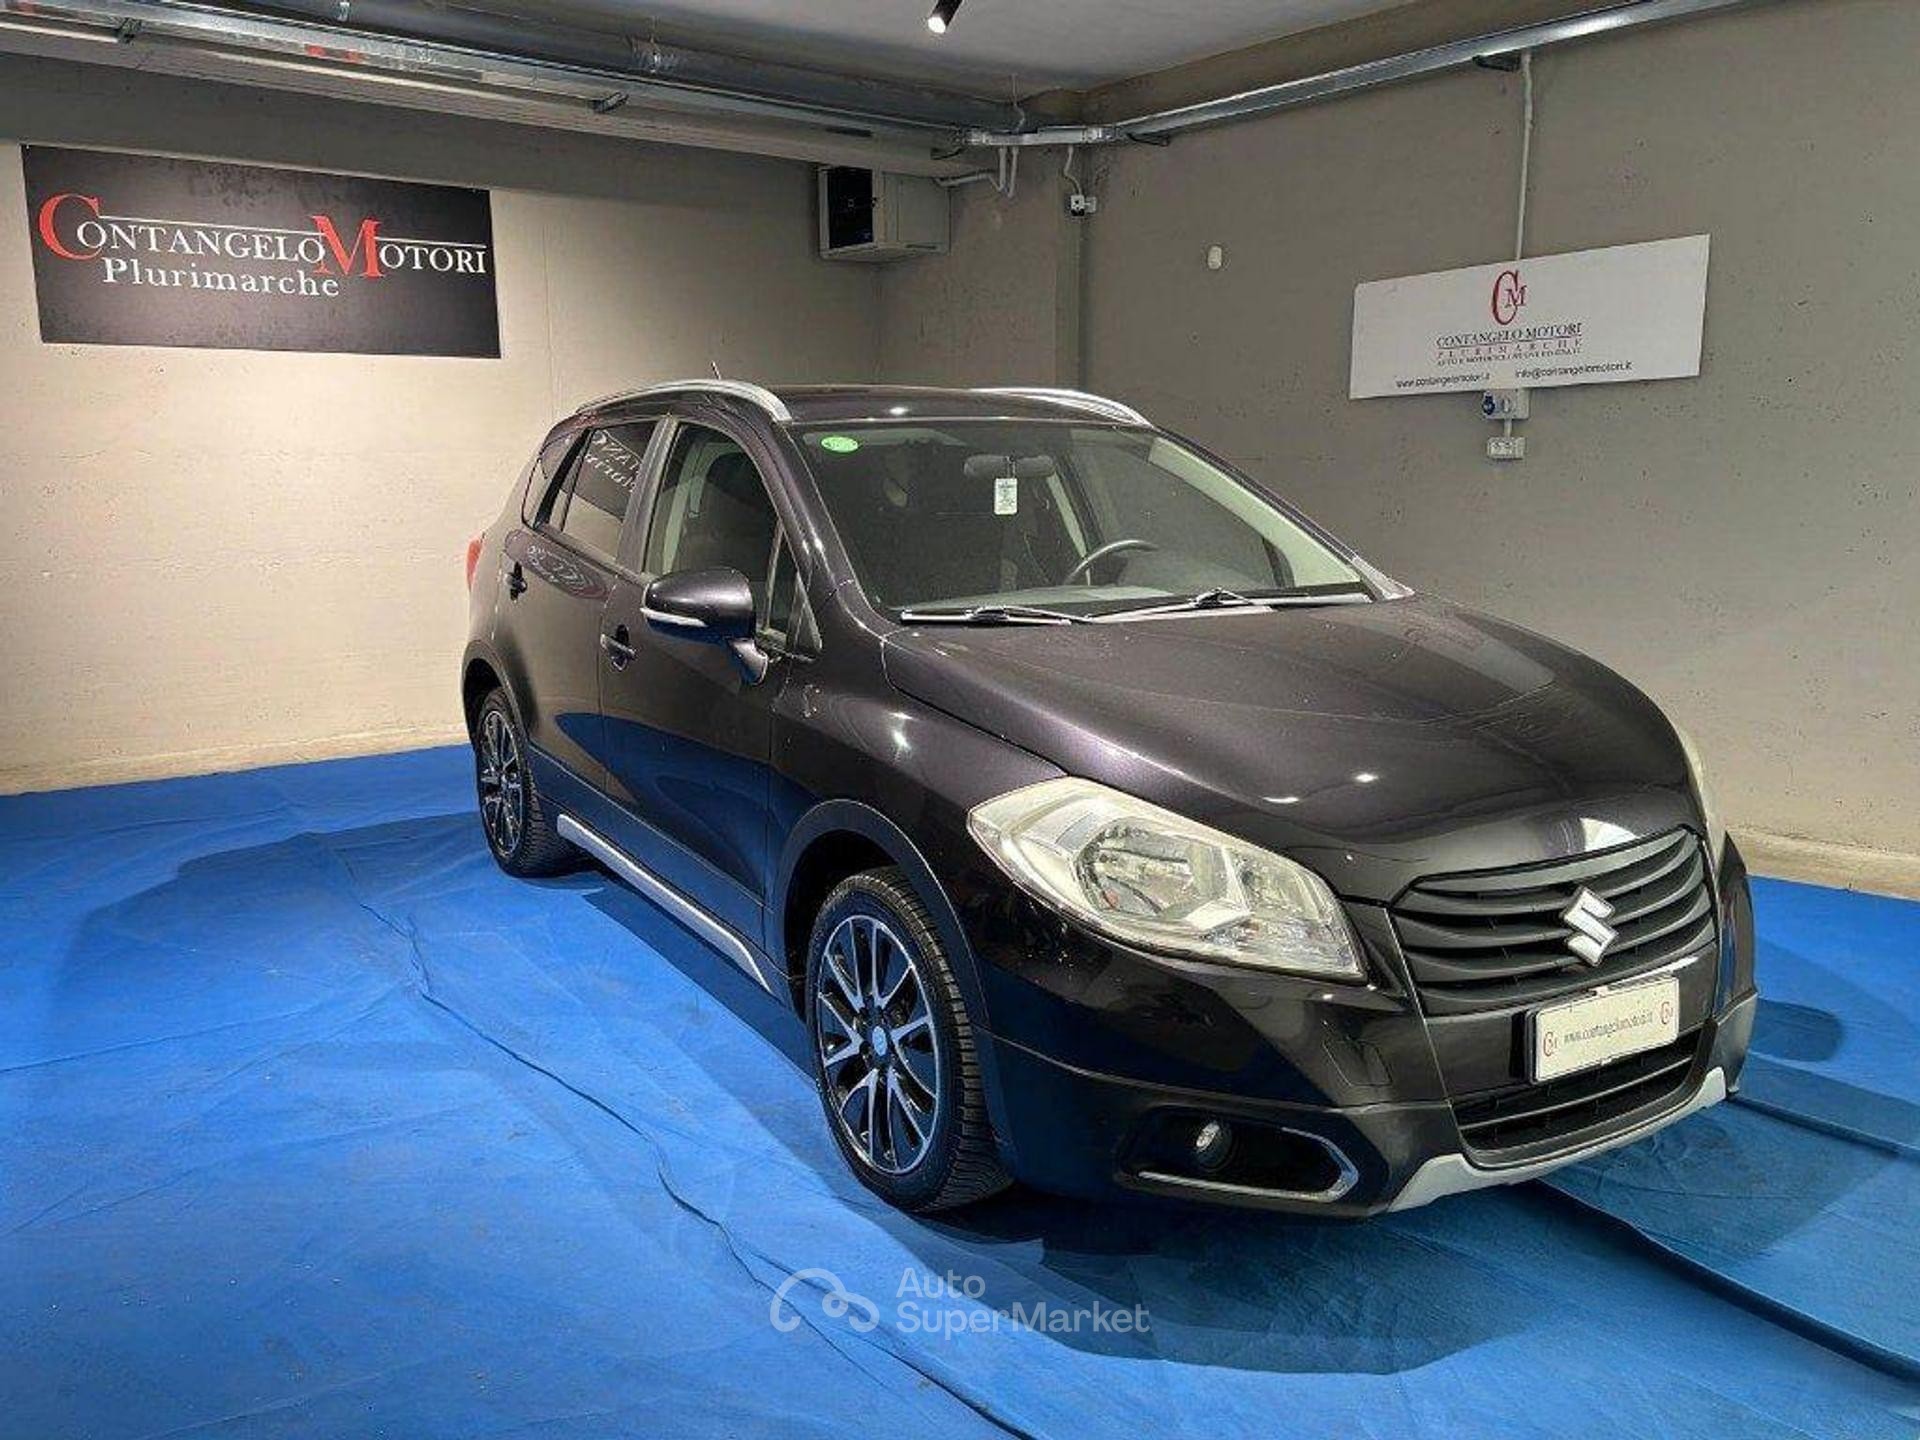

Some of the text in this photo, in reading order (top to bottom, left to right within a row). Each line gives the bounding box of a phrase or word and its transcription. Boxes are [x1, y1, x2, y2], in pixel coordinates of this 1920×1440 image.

[102, 256, 340, 297] Plurimarche
[1436, 321, 1582, 347] CONTANGELO MOTORI
